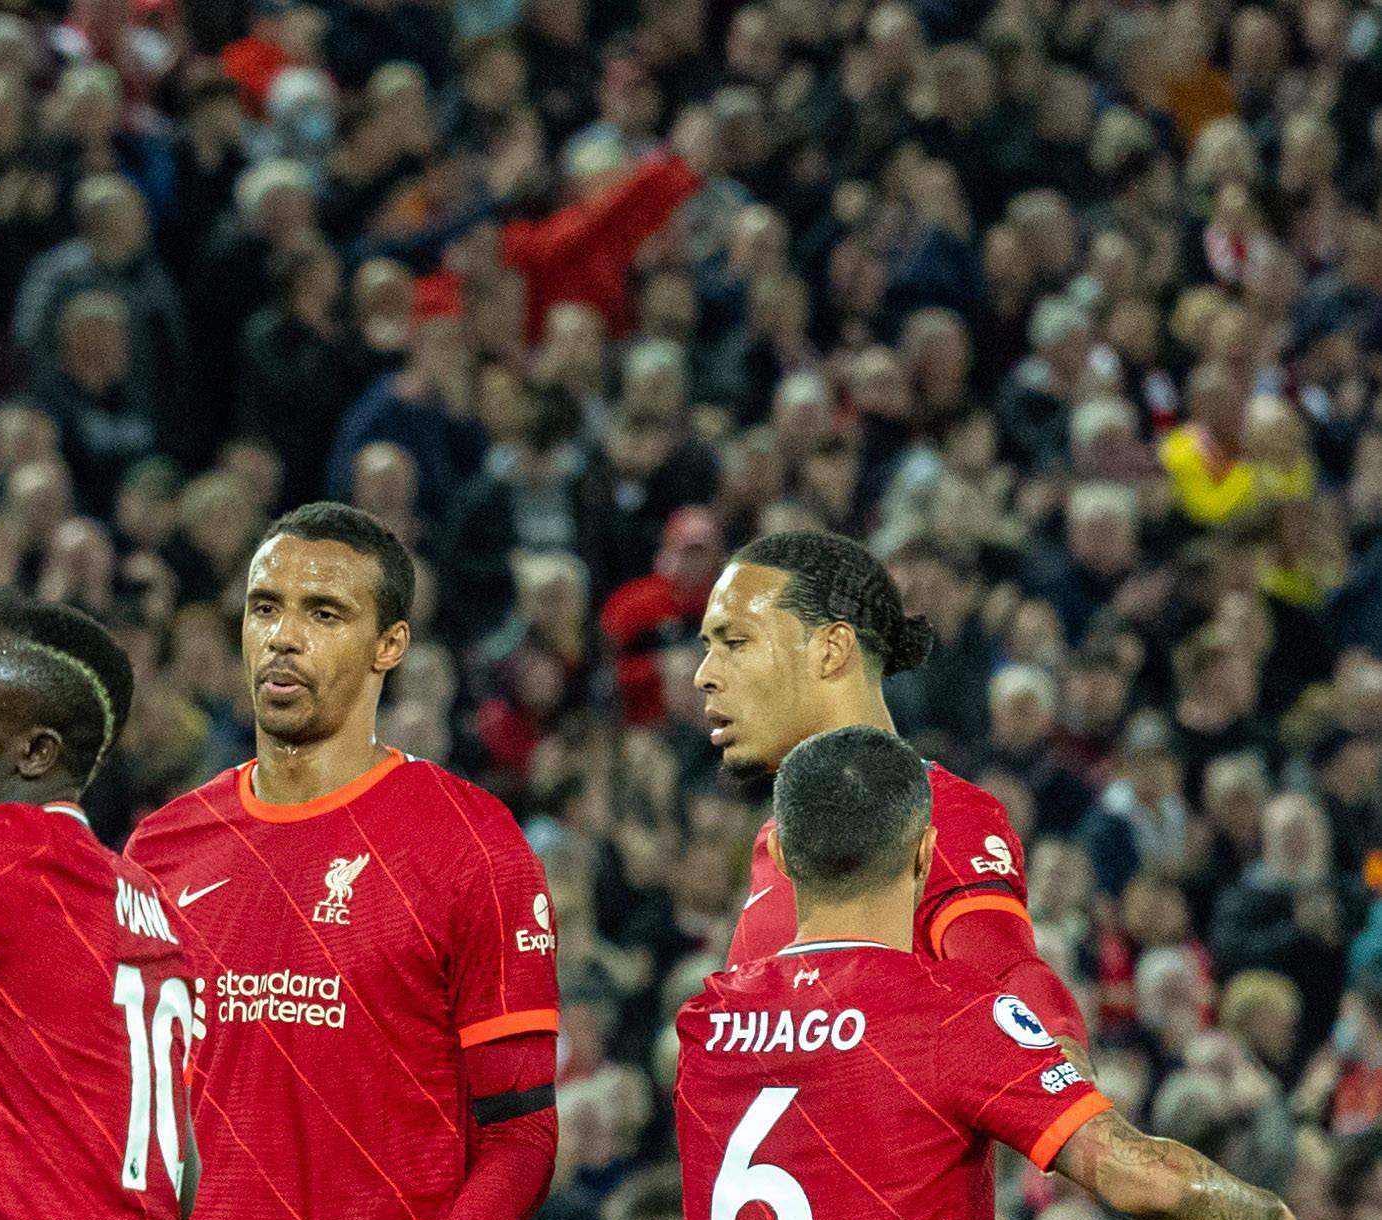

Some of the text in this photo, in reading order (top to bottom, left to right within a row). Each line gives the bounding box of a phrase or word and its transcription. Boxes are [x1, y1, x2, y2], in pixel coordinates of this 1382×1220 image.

[215, 968, 340, 1001] standard
[217, 994, 347, 1029] chartered
[705, 1008, 866, 1052] THIAGO
